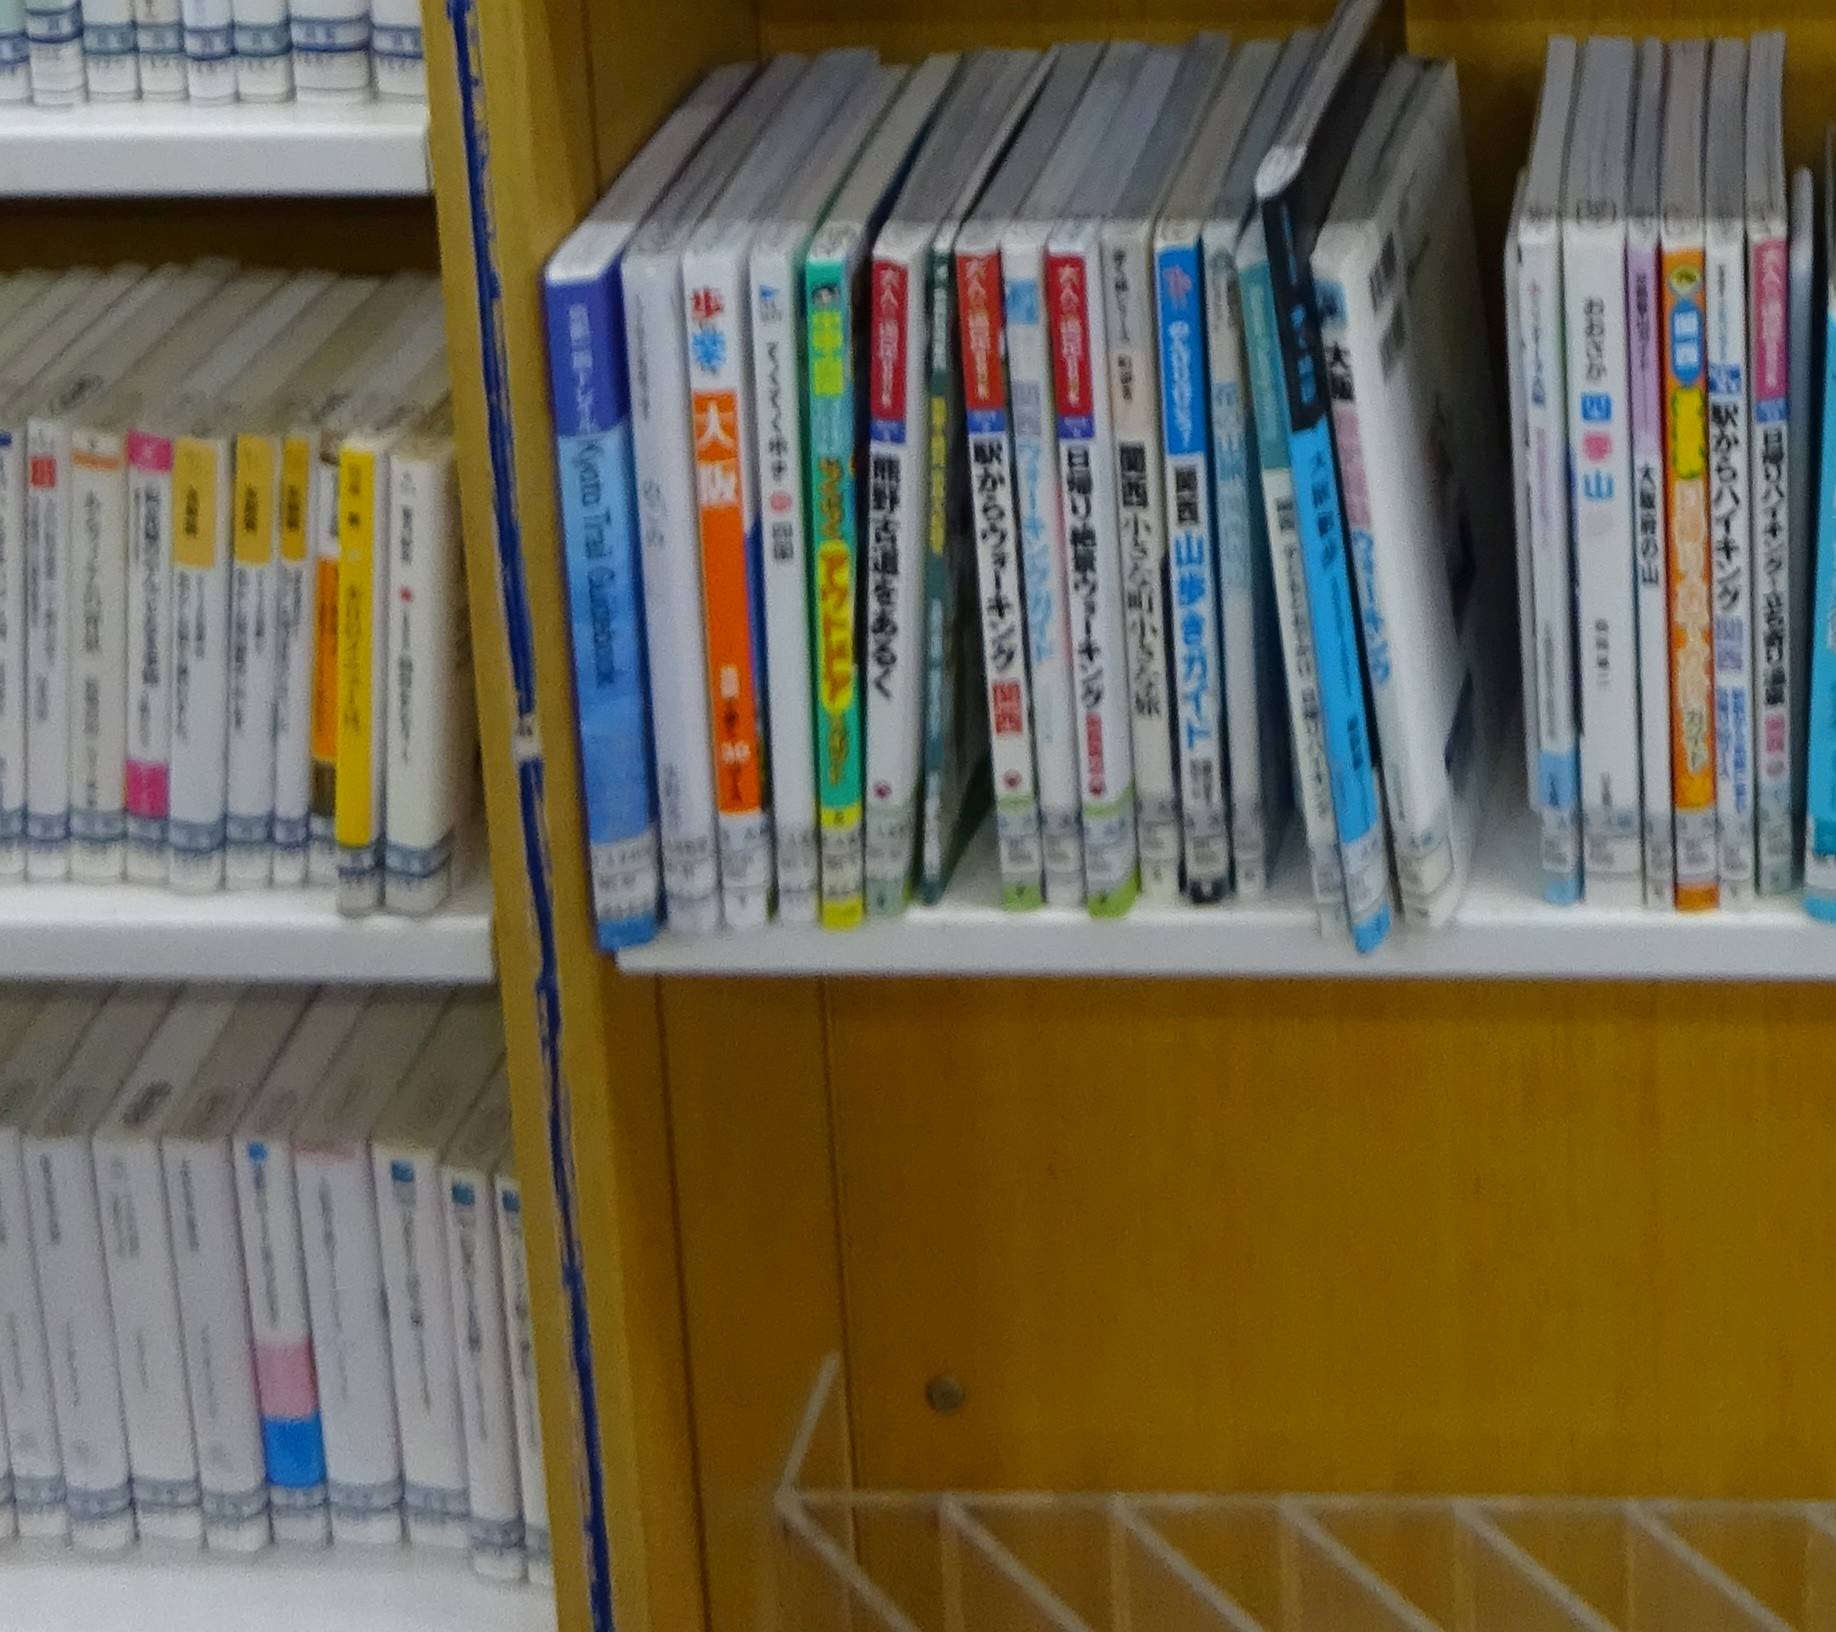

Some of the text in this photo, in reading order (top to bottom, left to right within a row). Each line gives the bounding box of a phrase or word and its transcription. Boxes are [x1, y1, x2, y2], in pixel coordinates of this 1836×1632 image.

[1711, 402, 1742, 610] 駅からハイキング
